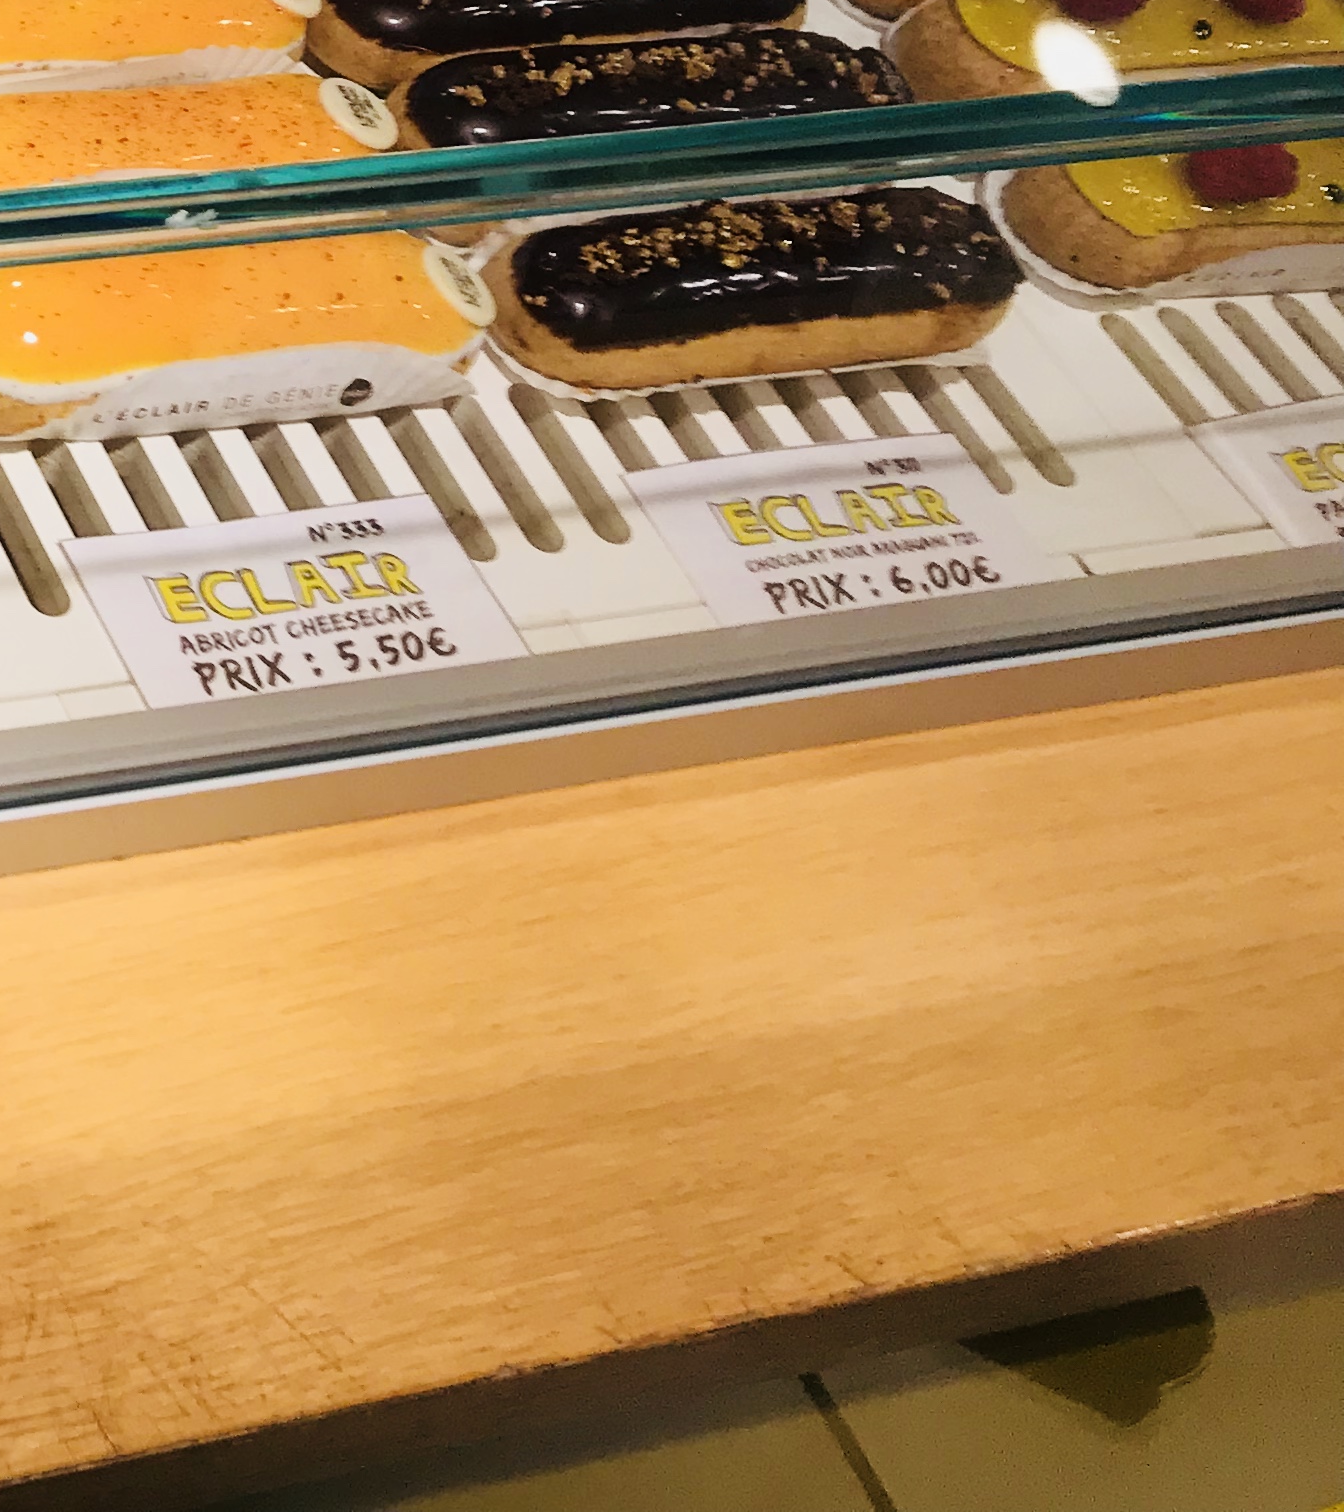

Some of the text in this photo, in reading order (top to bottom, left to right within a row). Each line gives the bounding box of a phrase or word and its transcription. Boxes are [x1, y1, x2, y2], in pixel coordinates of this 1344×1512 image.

[306, 518, 385, 544] N°333
[706, 482, 962, 546] ECLAIR
[142, 549, 423, 624] ECLAIR
[763, 571, 859, 615] PRIX
[888, 554, 1002, 595] 6,00€
[179, 600, 434, 657] ABRICOT CHEESECAKE
[191, 651, 293, 697] PRIX
[335, 626, 459, 674] 5,50€
